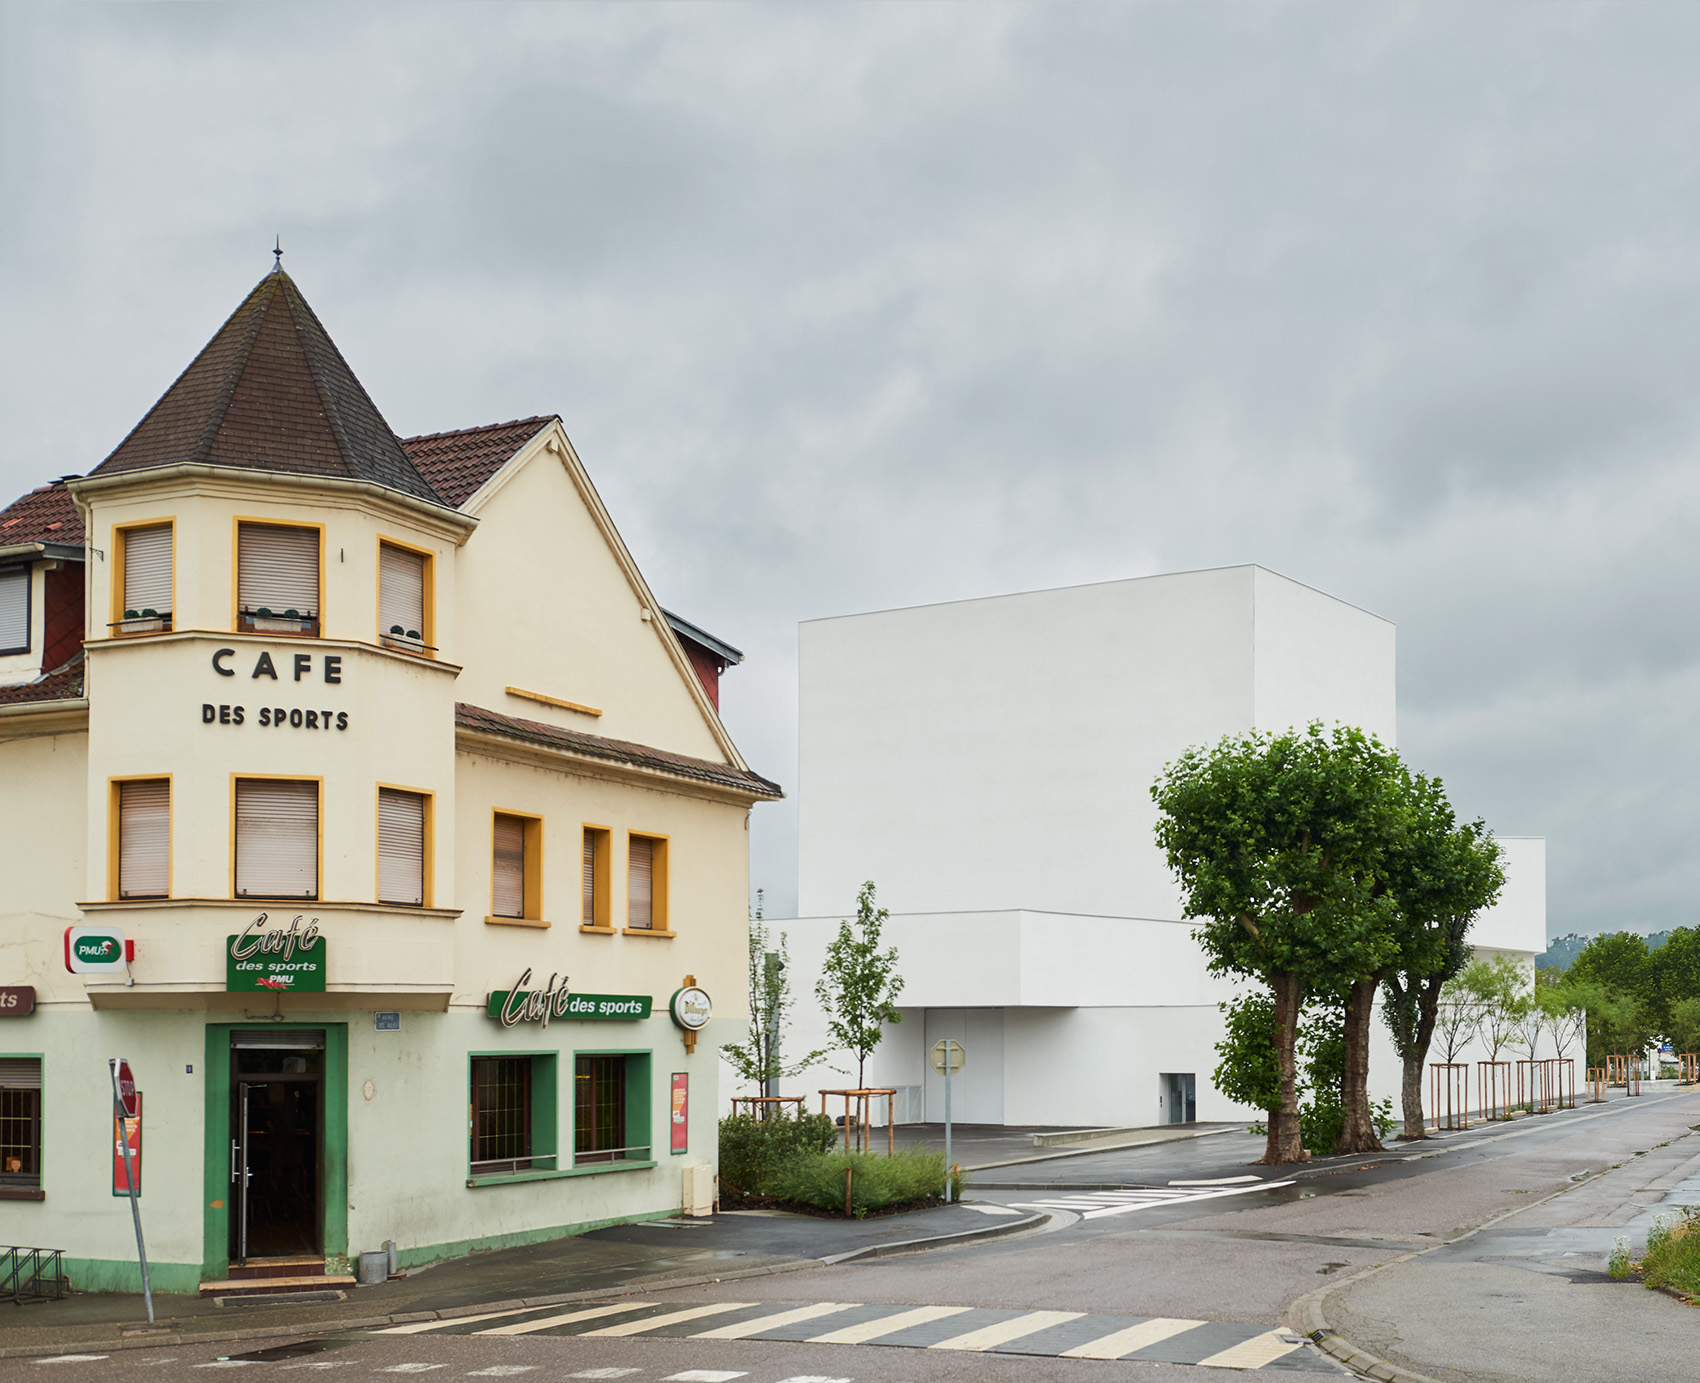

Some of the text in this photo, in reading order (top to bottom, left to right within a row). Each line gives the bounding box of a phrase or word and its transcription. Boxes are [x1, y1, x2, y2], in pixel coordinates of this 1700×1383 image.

[212, 648, 341, 684] CAFE
[202, 704, 349, 731] DES SPORTS
[230, 911, 319, 961] Café
[79, 945, 101, 955] PMU
[235, 961, 317, 973] des sports
[269, 975, 294, 983] PMU
[500, 967, 643, 1030] Café des sports
[120, 1080, 135, 1096] STOP
